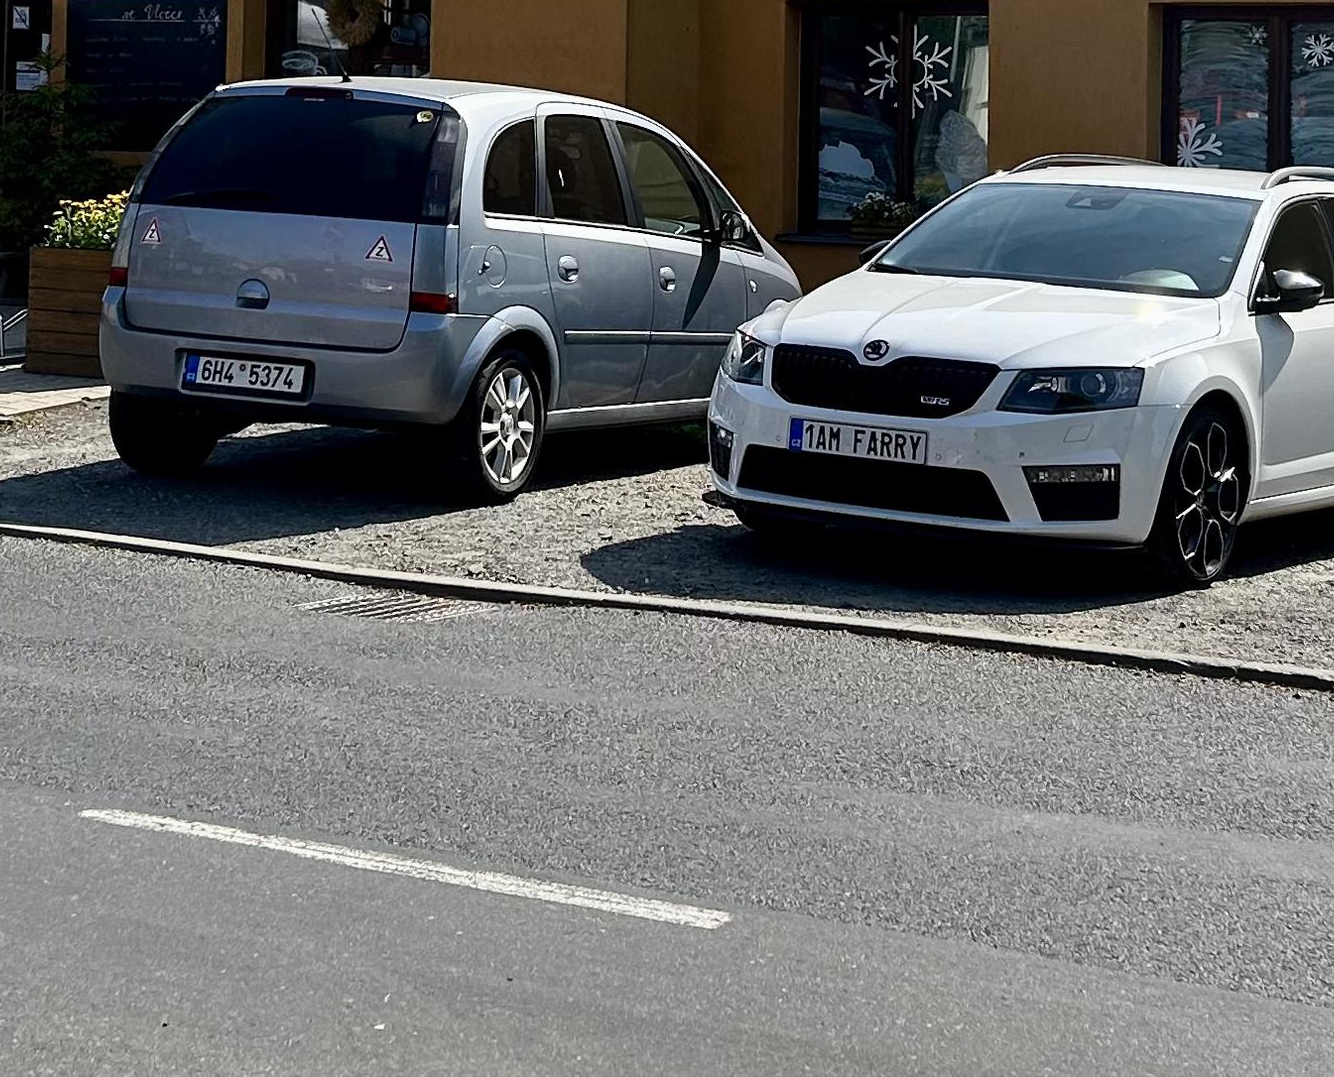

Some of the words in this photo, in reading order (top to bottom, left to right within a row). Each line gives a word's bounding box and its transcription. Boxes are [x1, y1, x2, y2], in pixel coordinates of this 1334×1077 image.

[201, 360, 234, 383] 6H4
[248, 364, 294, 389] 5374
[791, 438, 801, 447] CZ
[805, 423, 841, 452] 1AM
[853, 429, 922, 460] FARRY
